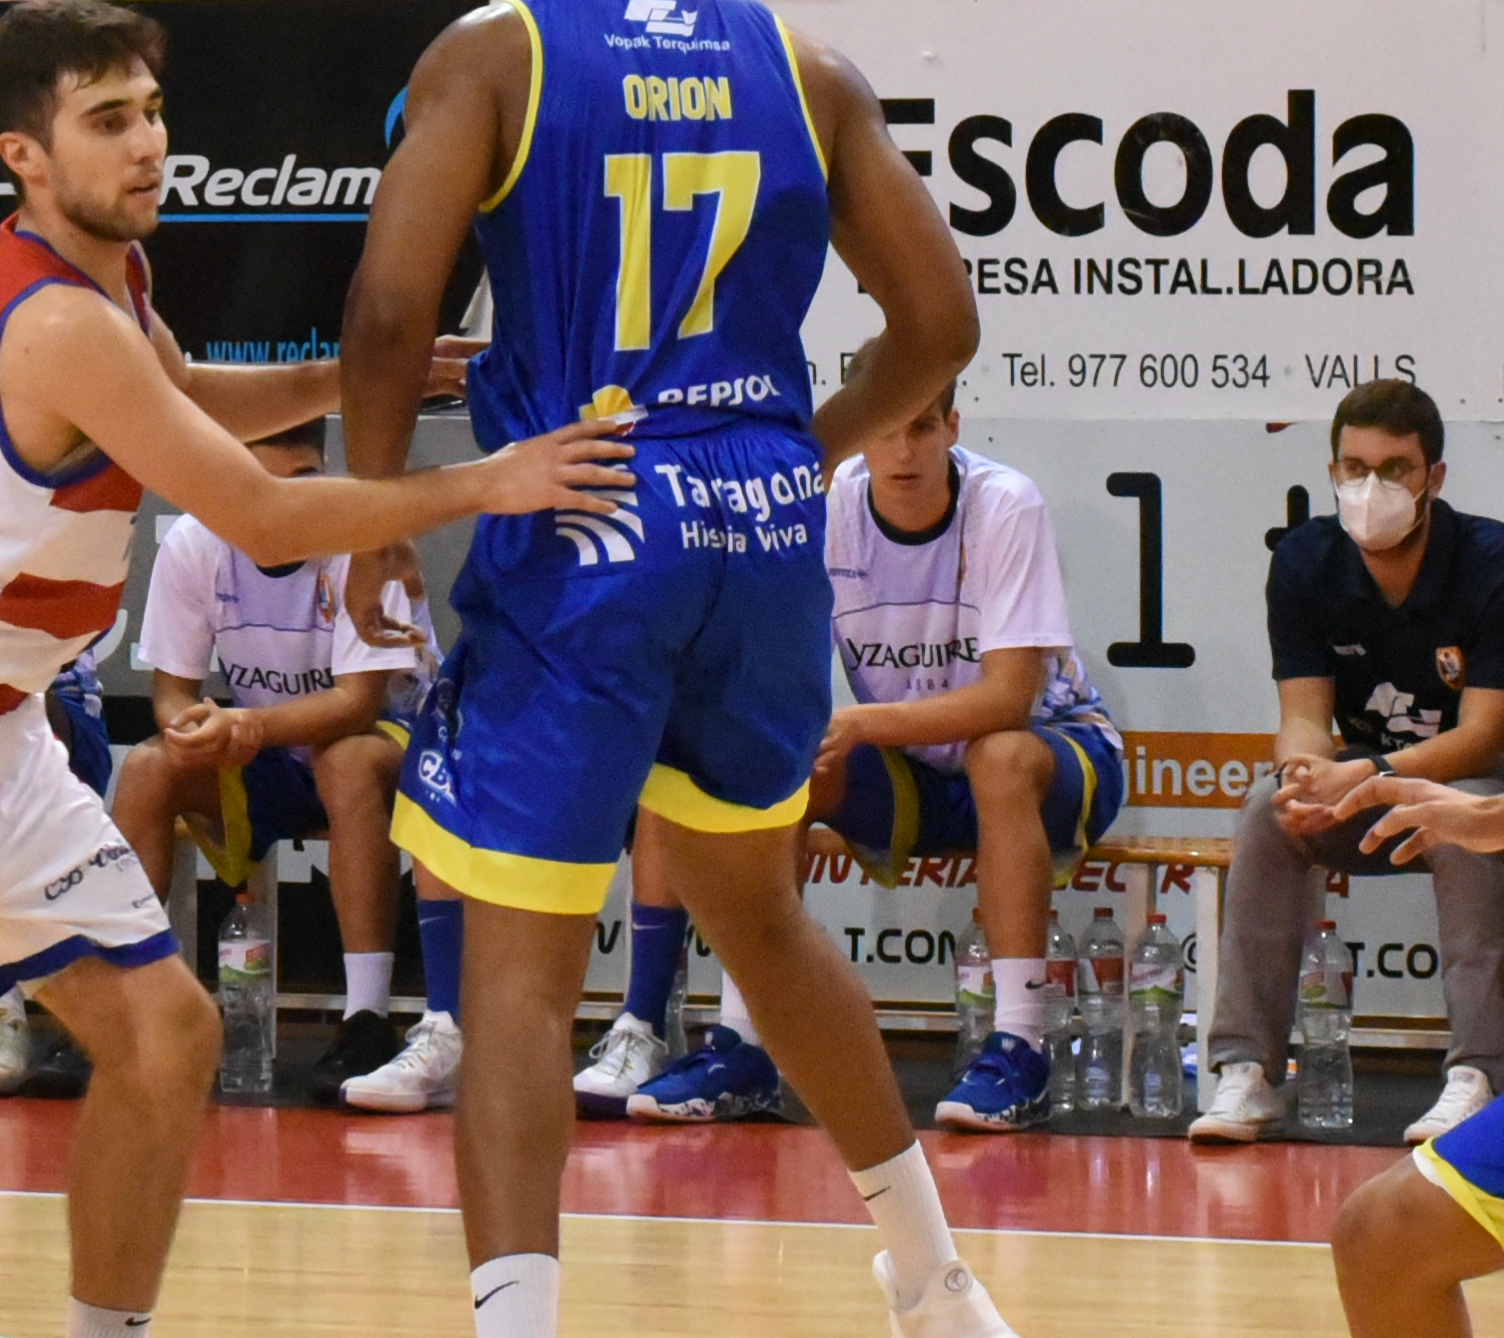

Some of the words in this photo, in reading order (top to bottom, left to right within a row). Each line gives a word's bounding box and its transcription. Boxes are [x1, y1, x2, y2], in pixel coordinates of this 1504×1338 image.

[604, 33, 650, 50] Vopak
[652, 35, 732, 55] Terquimsa
[622, 74, 733, 122] ORION
[603, 149, 761, 351] 17
[1073, 257, 1416, 297] INSTAL.LADORA
[1002, 353, 1056, 388] Tel.
[1068, 353, 1127, 388] 977
[1138, 353, 1200, 389] 600
[1210, 354, 1271, 389] 534
[755, 522, 808, 553] Viva
